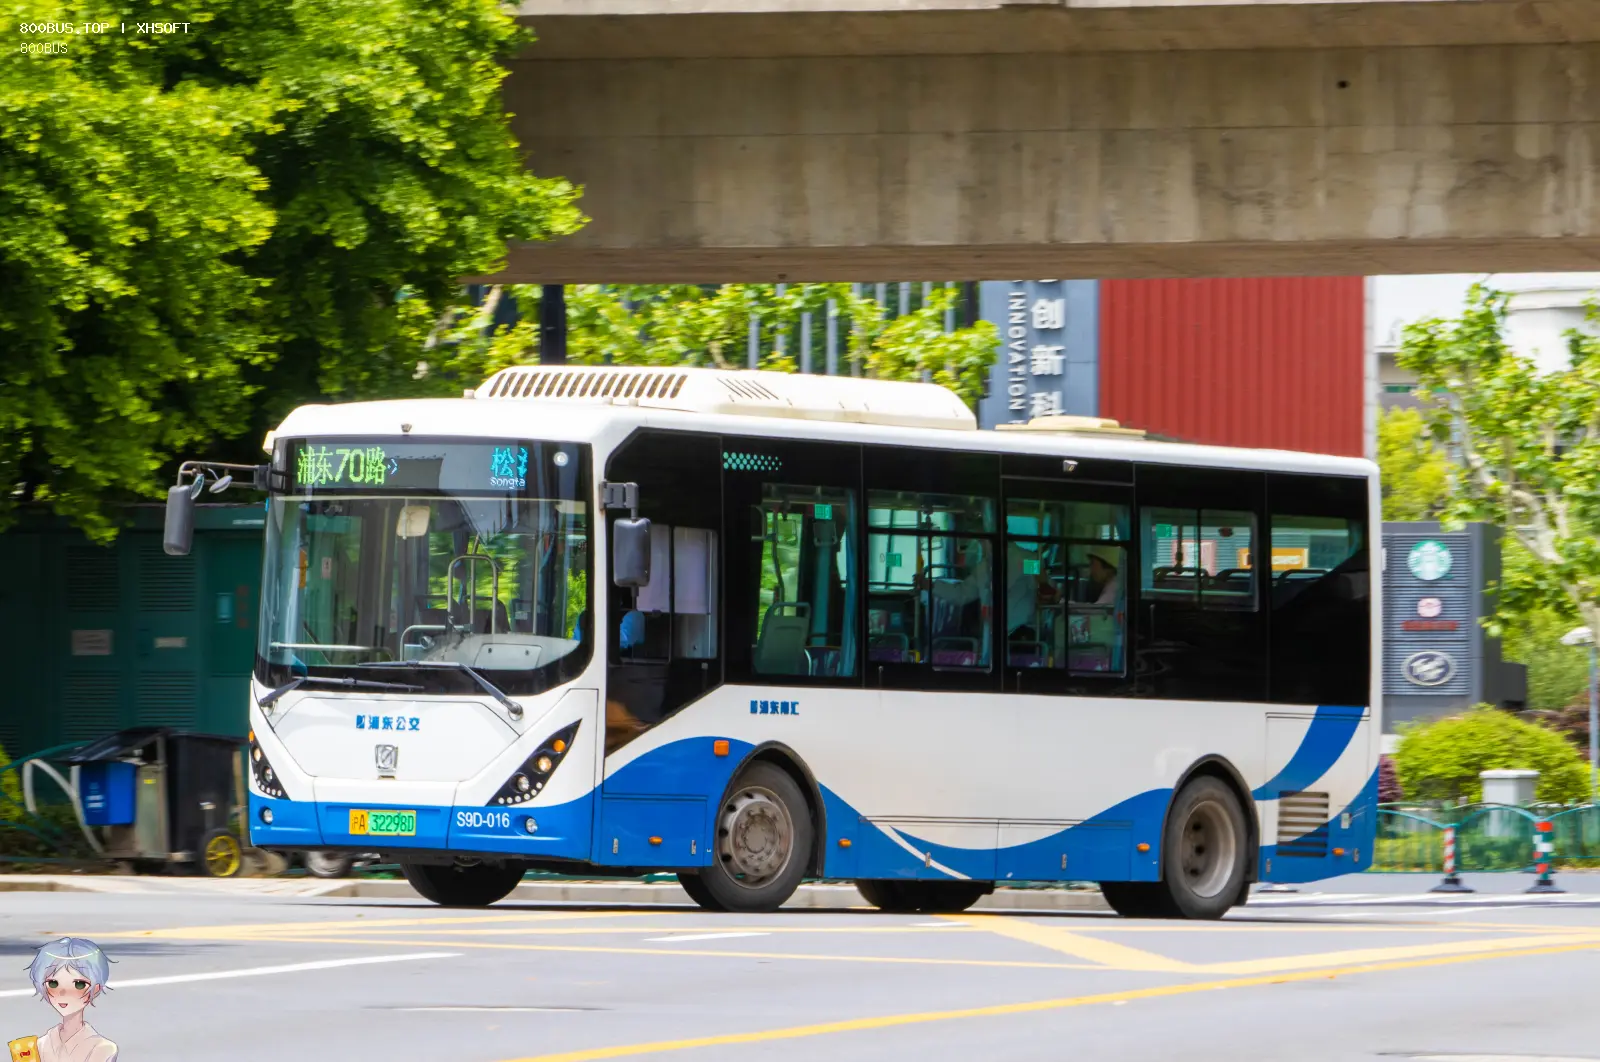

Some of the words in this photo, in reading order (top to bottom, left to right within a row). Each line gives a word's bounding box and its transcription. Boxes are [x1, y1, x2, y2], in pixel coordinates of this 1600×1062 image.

[1008, 291, 1027, 410] INNOVATION
[1029, 279, 1067, 417] 创新科
[297, 446, 387, 485] 浦东70路
[368, 715, 420, 731] 浦东公交
[456, 811, 510, 828] S9D-016
